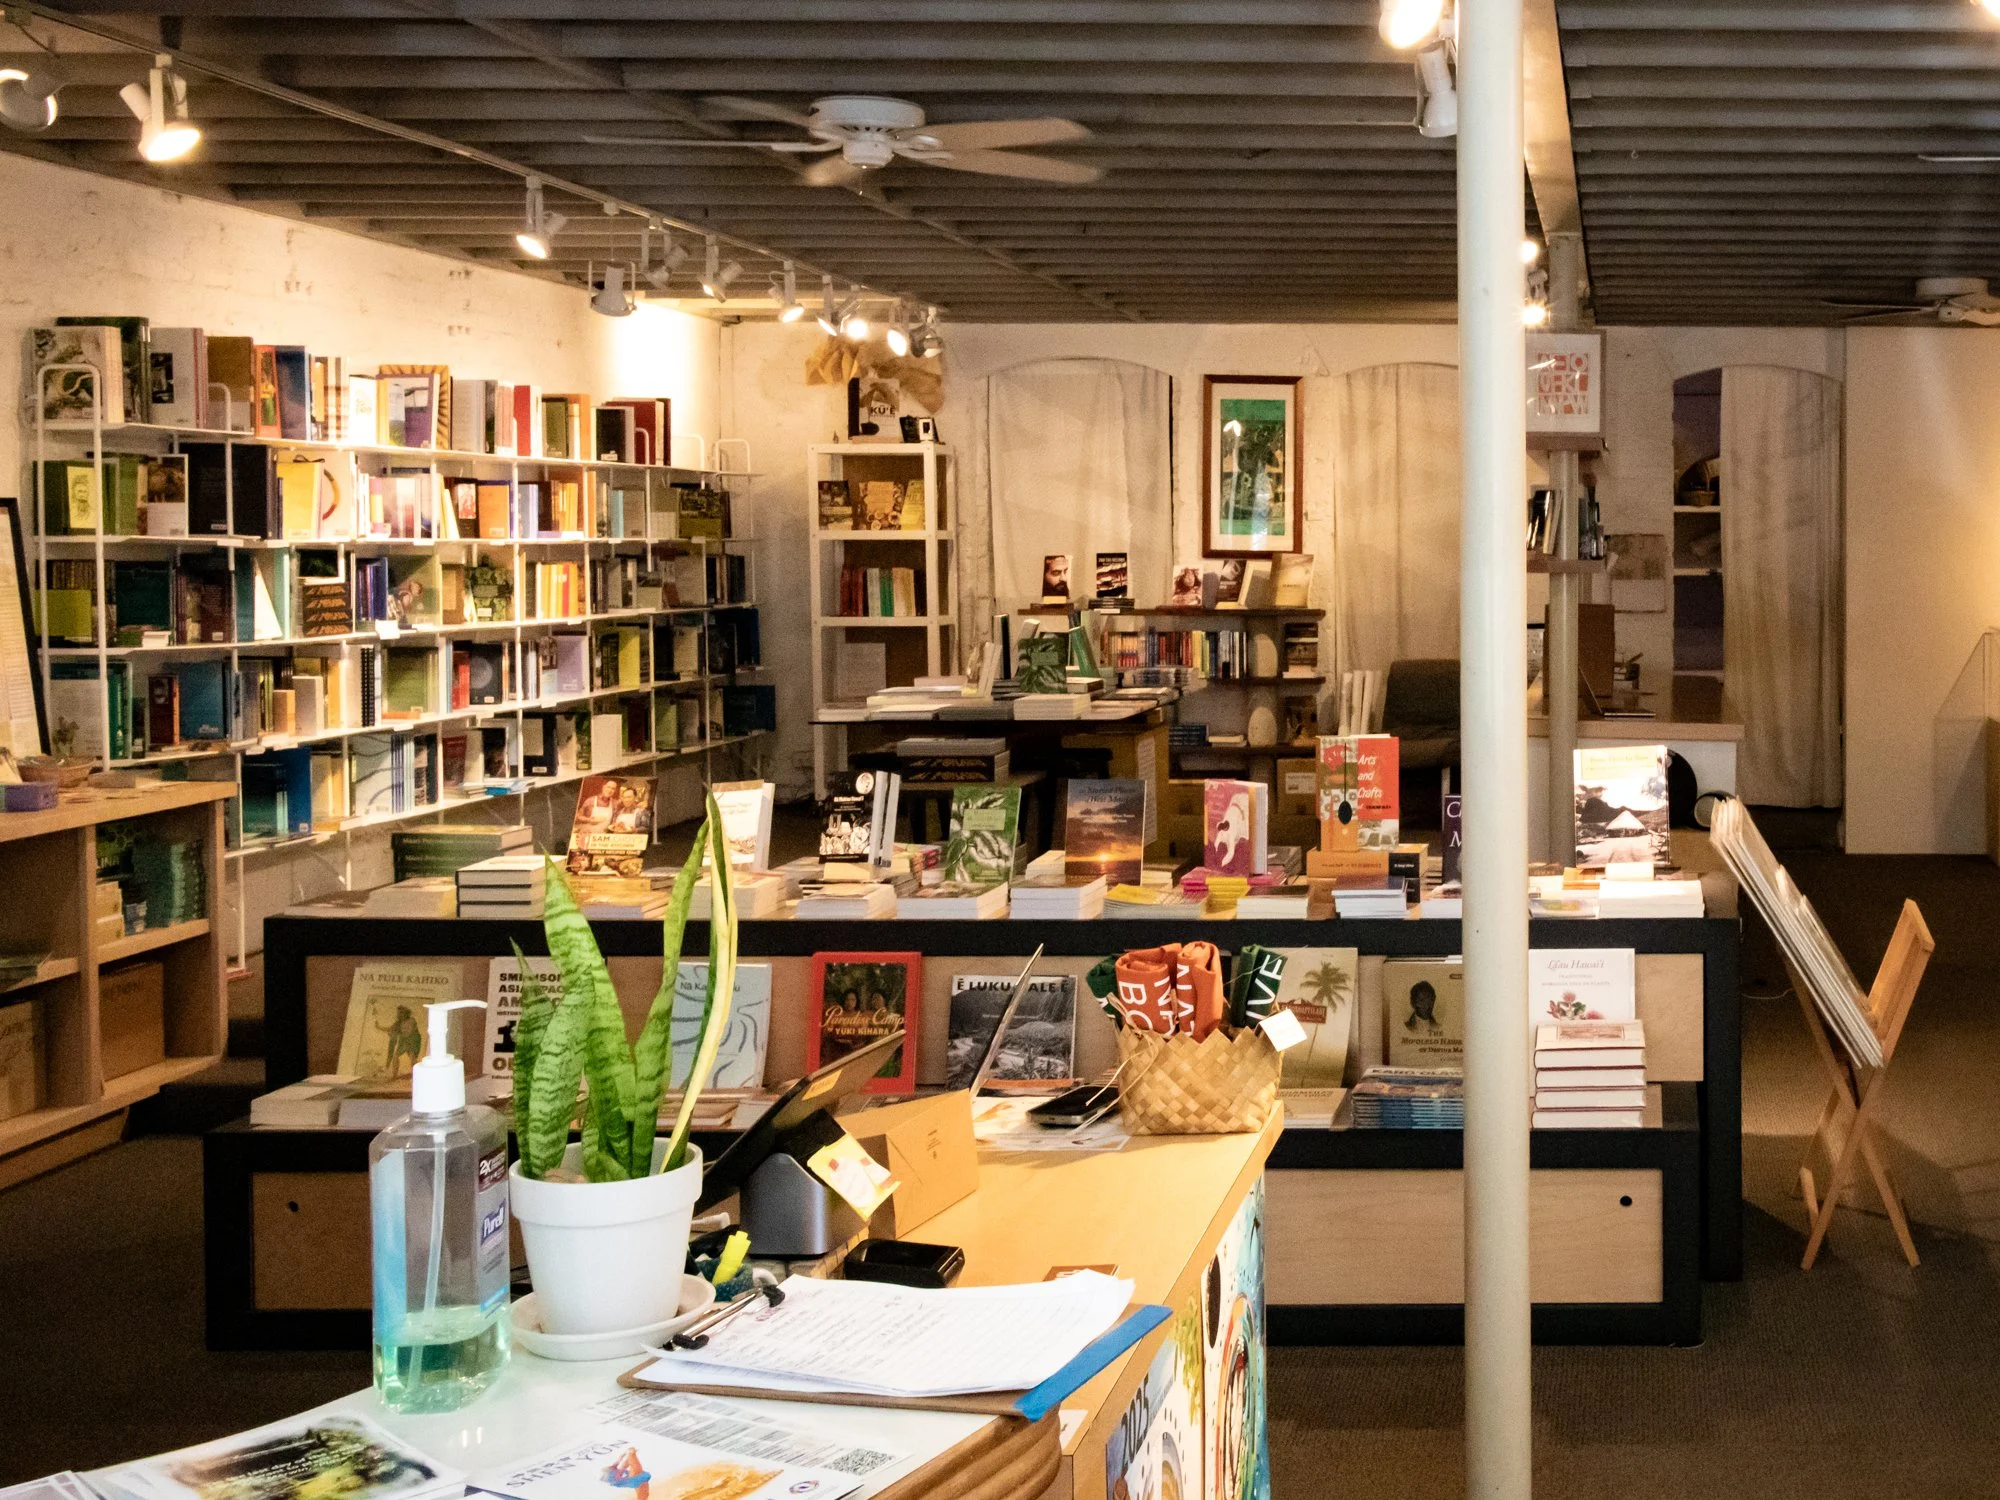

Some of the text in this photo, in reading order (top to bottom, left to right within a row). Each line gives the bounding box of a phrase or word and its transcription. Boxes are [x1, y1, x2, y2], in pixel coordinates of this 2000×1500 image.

[1358, 754, 1377, 765] Arts
[1358, 770, 1375, 781] and
[1357, 786, 1383, 799] Crafts
[406, 975, 449, 985] KAHIKO
[969, 981, 1011, 992] LUKU
[872, 1006, 904, 1034] Camp
[836, 1027, 855, 1035] YUKI
[858, 1027, 889, 1035] KIHARA
[577, 1440, 629, 1461] YUN
